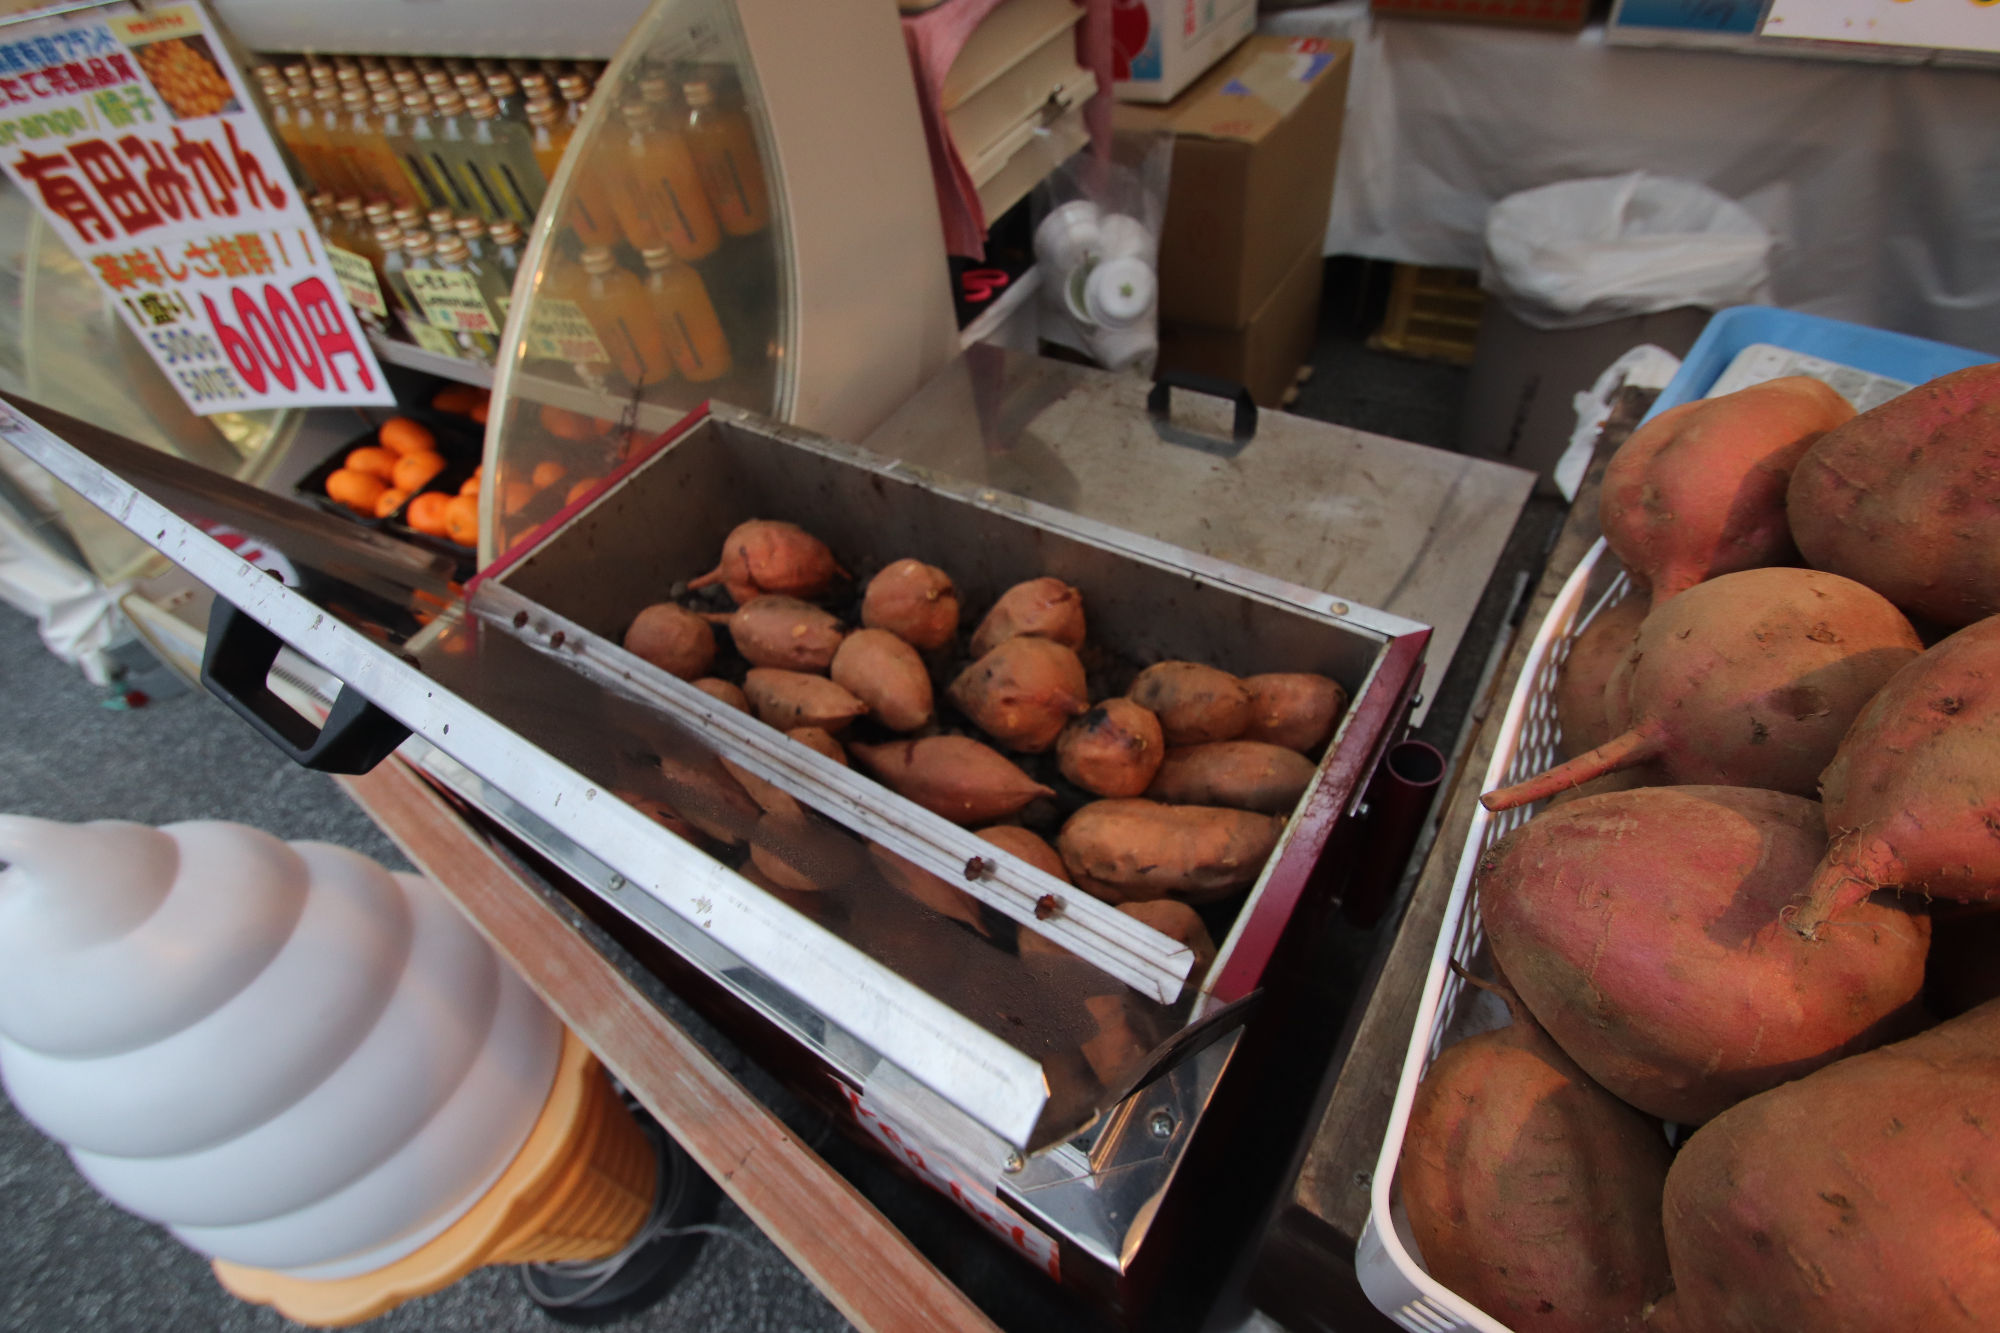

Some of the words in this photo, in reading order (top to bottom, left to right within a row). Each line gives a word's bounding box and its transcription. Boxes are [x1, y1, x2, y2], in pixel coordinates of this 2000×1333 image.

[13, 119, 287, 244] 有田みかん
[198, 275, 376, 394] 600円
